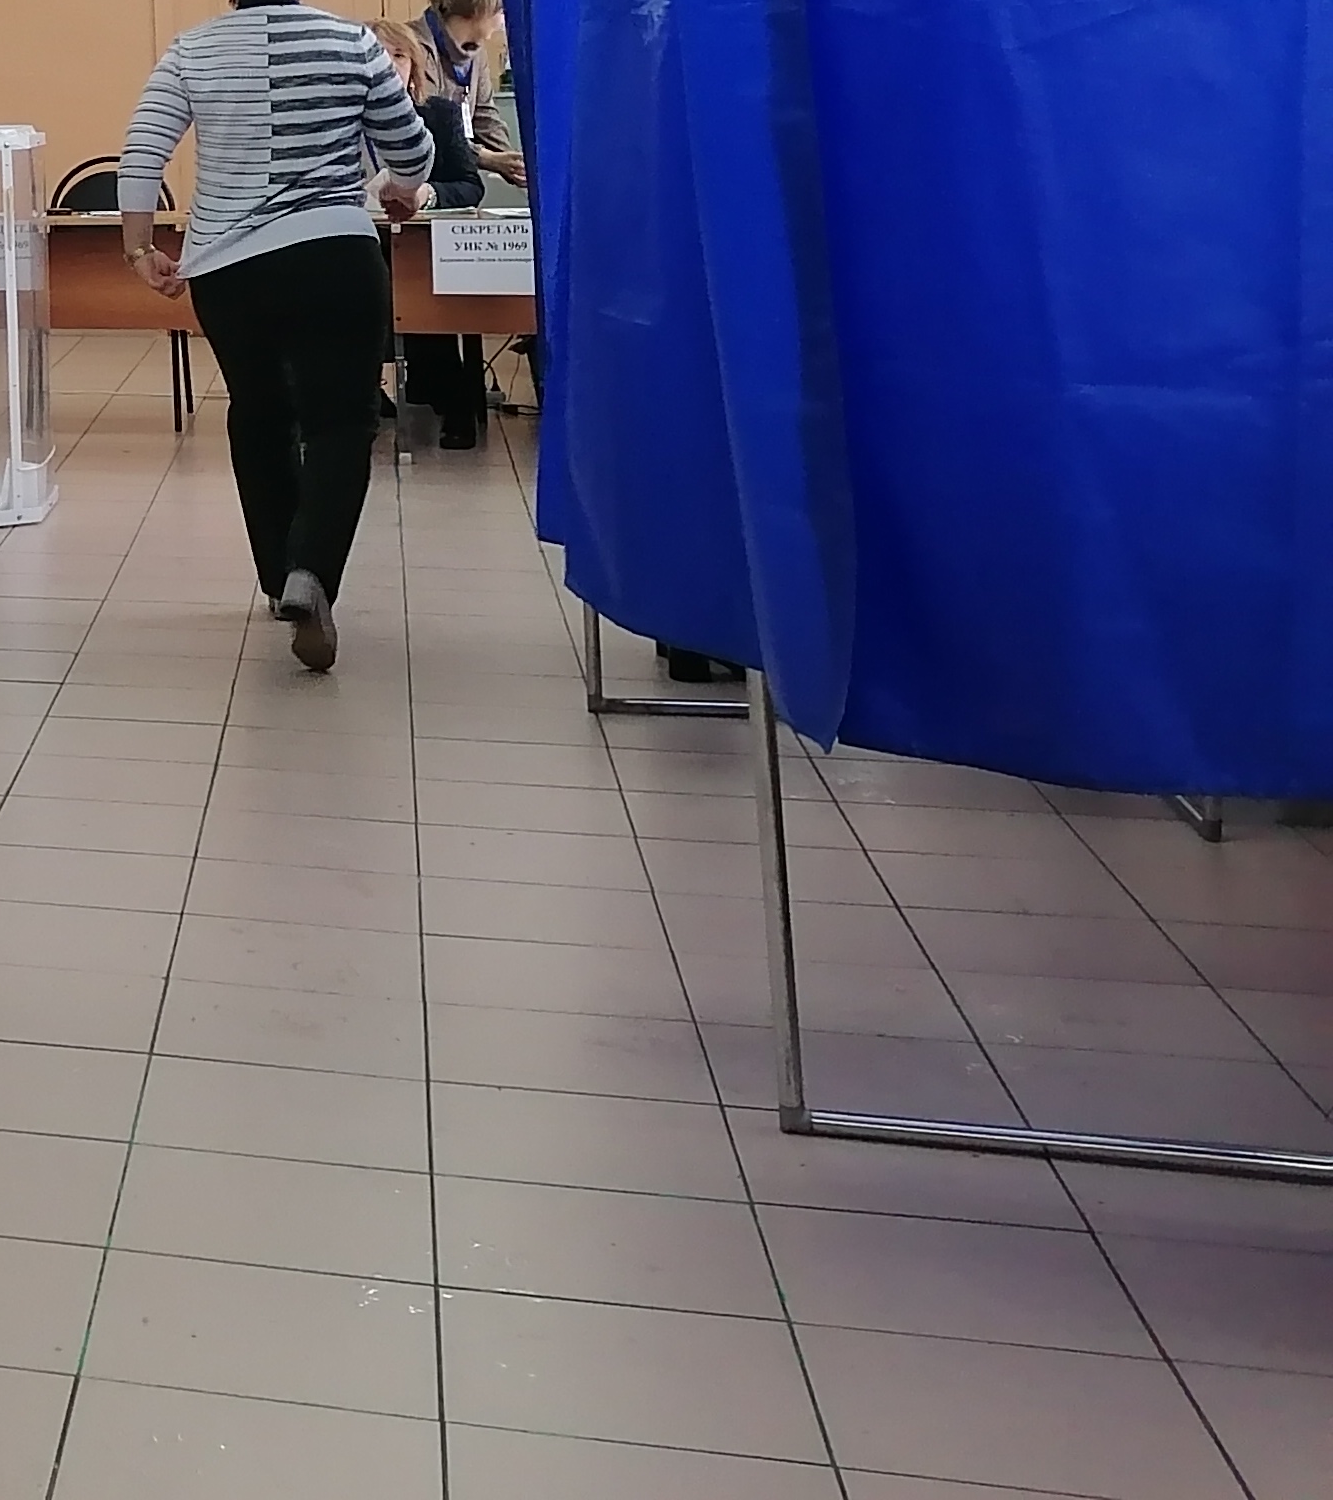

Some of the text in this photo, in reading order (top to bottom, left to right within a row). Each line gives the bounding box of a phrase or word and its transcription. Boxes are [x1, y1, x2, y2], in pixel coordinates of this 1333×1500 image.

[451, 225, 529, 235] СЕКРЕТАРЬ
[454, 242, 482, 251] УИК
[502, 242, 528, 251] 1969
